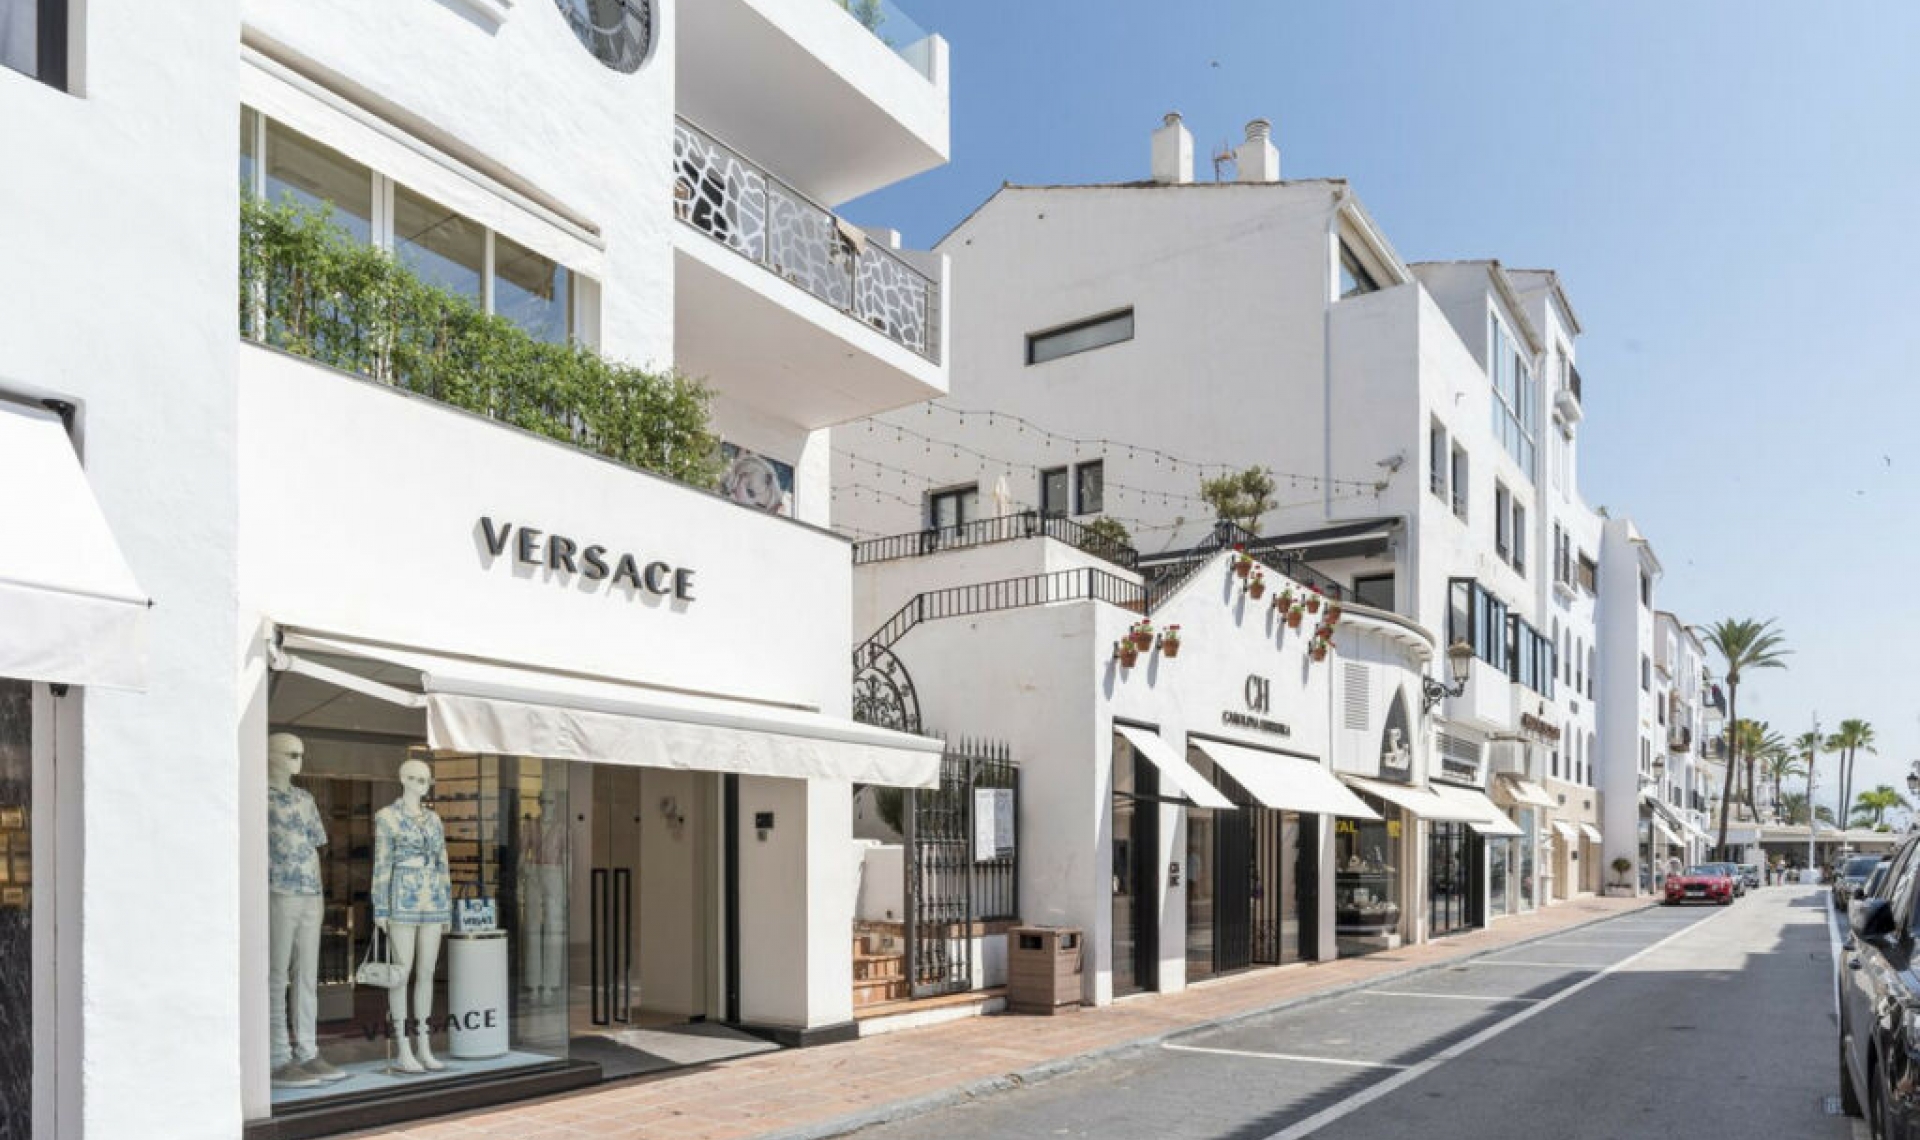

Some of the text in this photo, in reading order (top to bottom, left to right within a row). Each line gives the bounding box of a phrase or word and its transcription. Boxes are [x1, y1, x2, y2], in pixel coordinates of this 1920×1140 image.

[479, 516, 696, 602] VERSACE
[1245, 673, 1270, 714] CH
[362, 1008, 497, 1041] VERSACE
